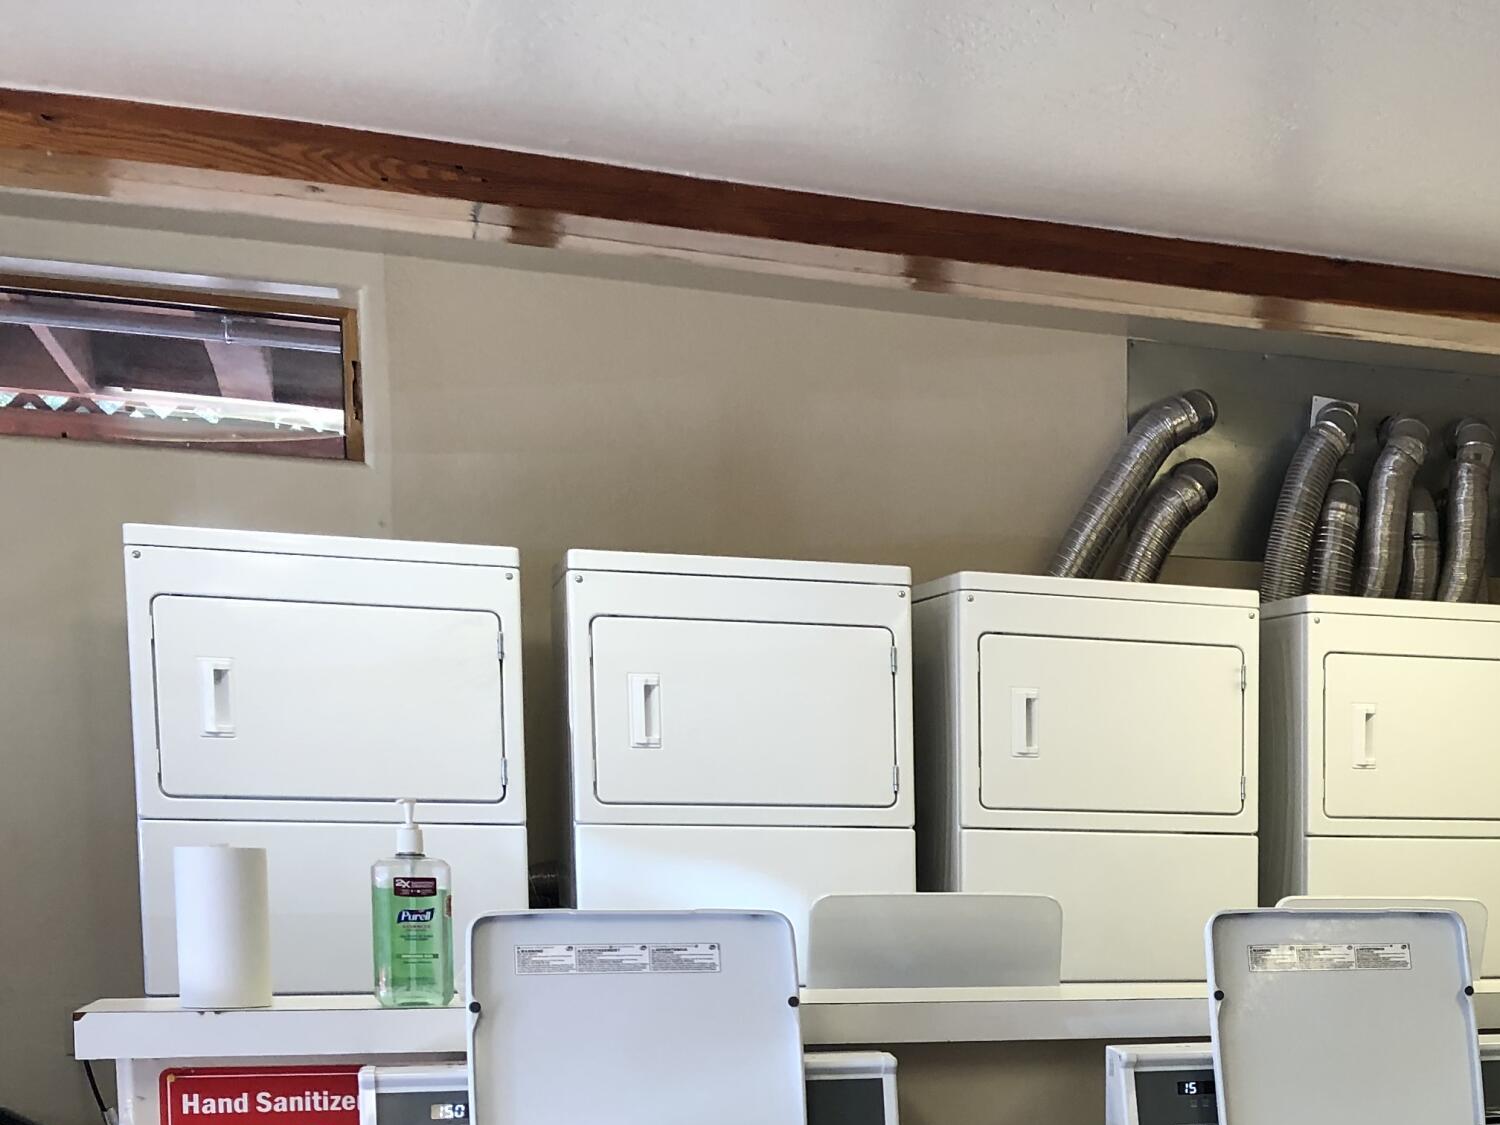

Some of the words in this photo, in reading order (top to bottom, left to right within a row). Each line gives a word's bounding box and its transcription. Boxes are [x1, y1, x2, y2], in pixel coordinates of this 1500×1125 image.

[1184, 1081, 1197, 1094] 15
[182, 1092, 249, 1115] Hand
[255, 1090, 360, 1113] Sanitize
